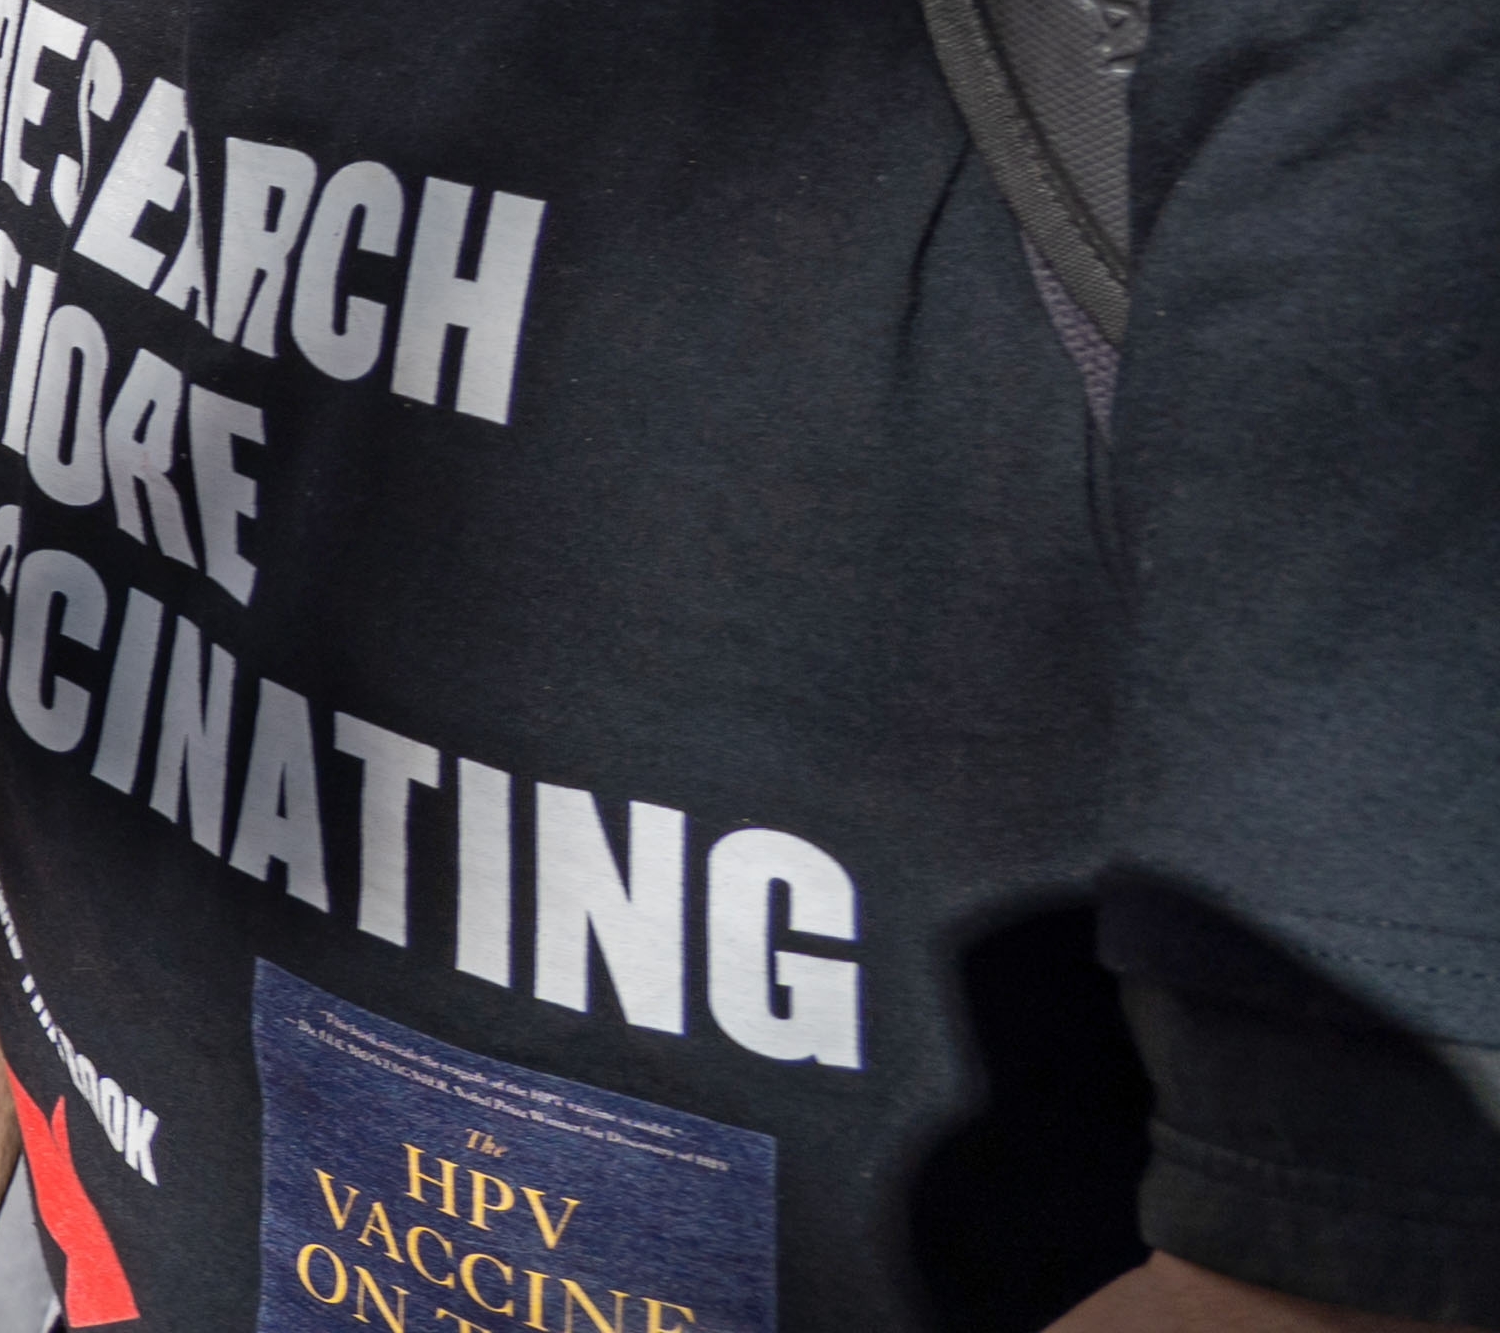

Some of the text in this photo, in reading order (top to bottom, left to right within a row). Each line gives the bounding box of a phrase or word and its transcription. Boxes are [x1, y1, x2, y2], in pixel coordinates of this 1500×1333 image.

[464, 1127, 509, 1158] The
[402, 1142, 582, 1250] HPV
[296, 1243, 412, 1333] ON
[313, 1167, 697, 1333] VACCINE
